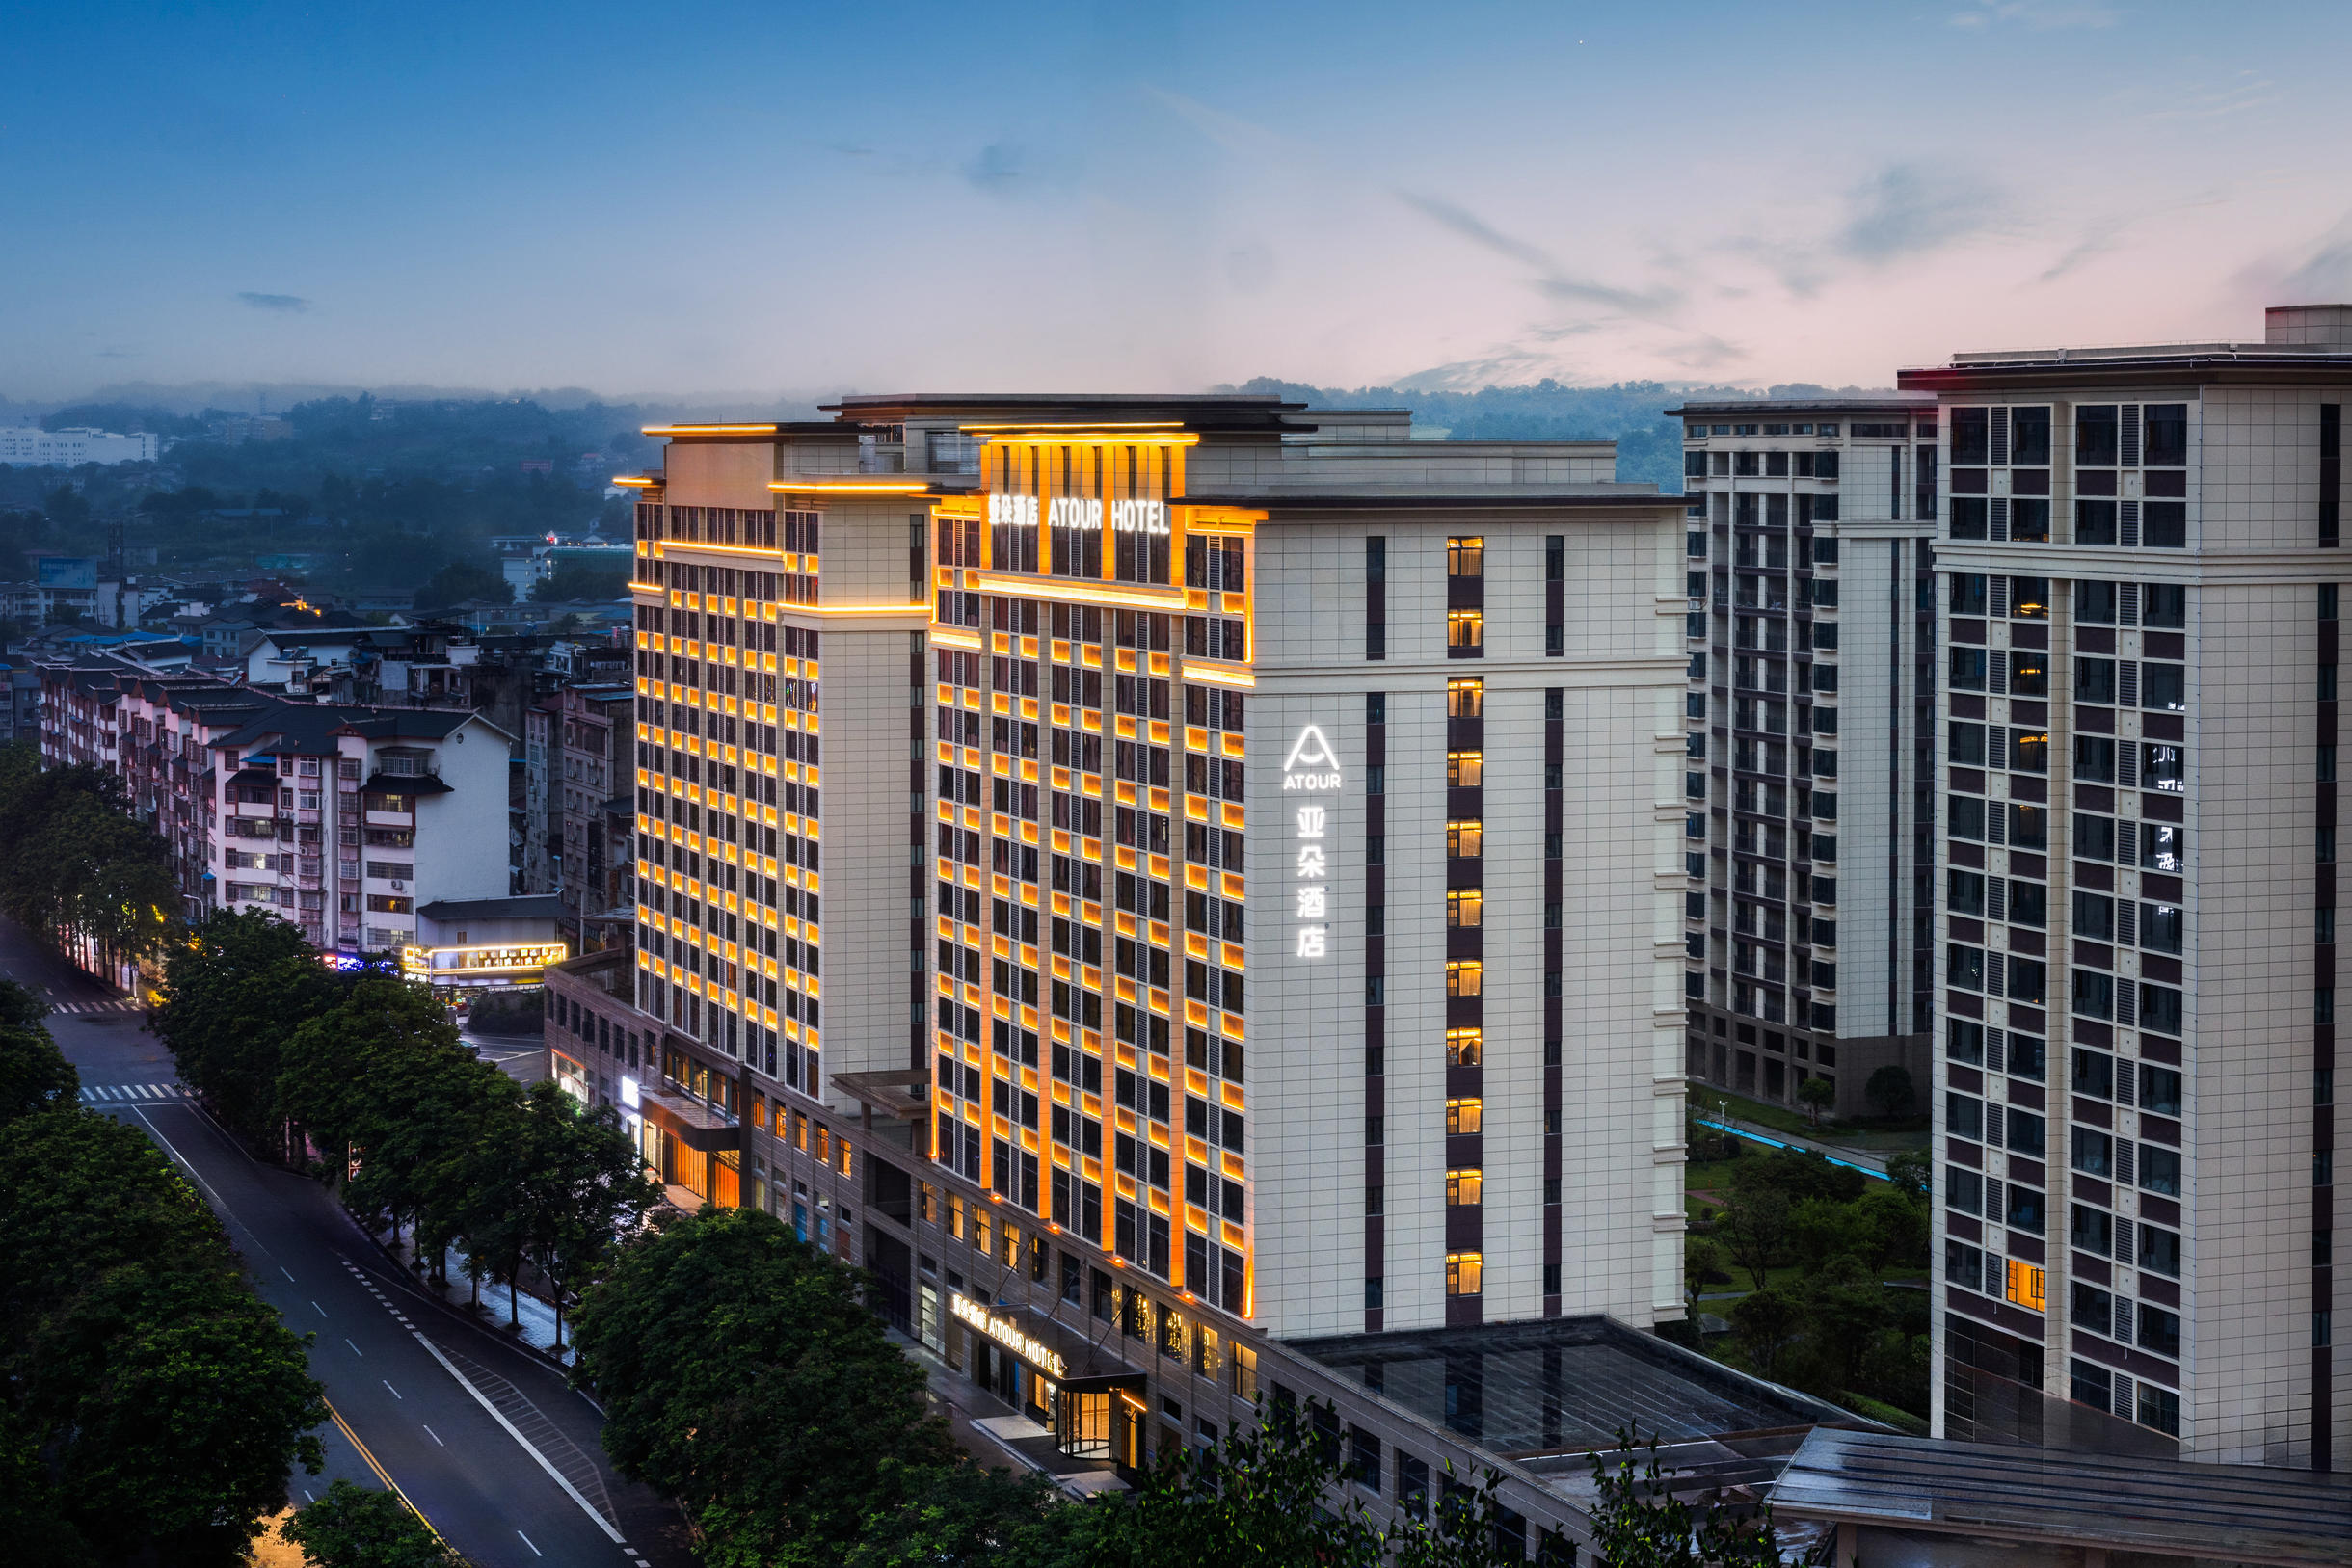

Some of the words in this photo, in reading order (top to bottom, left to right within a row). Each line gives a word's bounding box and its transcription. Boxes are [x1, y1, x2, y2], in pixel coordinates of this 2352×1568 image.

[1048, 498, 1102, 529] ATOUR
[1111, 500, 1169, 534] HOTEL
[1284, 774, 1341, 789] ATOUR
[1297, 807, 1325, 957] 亚朵酒店
[989, 1317, 1025, 1351] ATOUR
[1026, 1338, 1063, 1376] HOTEL
